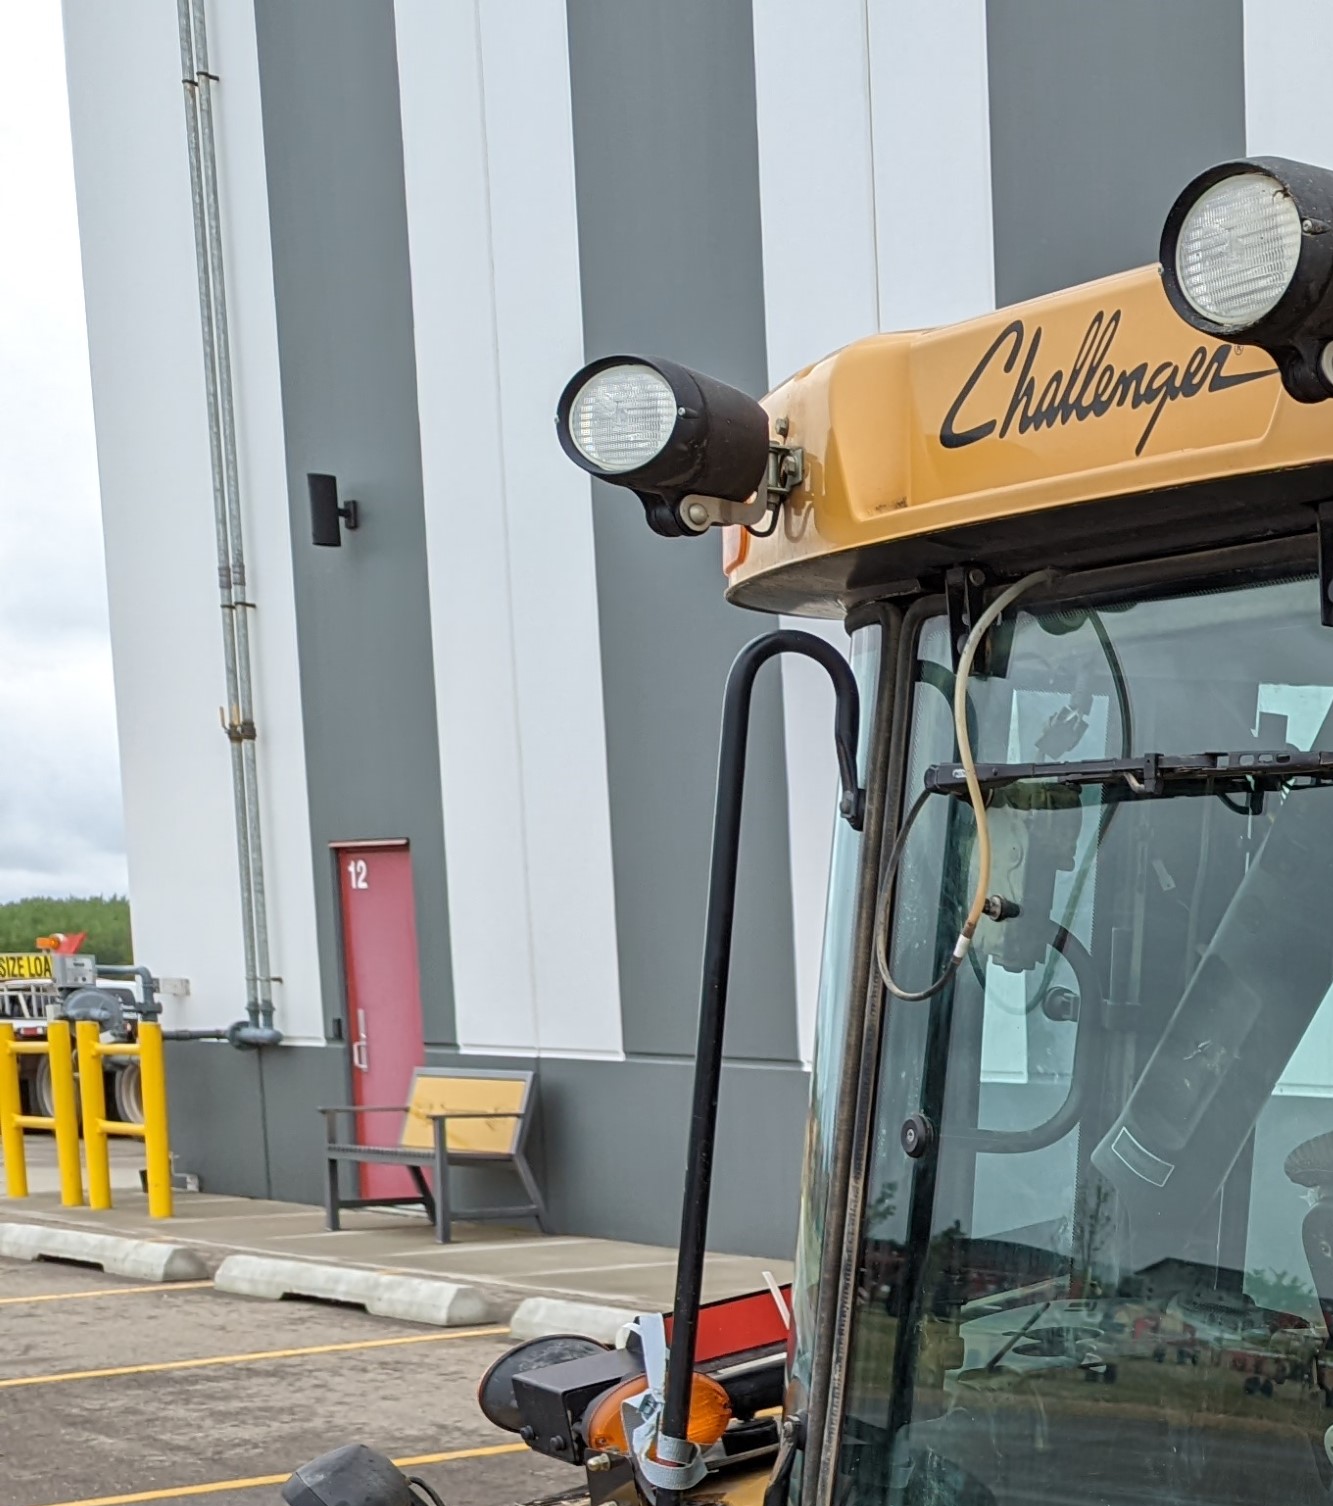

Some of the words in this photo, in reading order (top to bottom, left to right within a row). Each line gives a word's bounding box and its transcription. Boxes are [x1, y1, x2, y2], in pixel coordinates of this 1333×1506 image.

[939, 309, 1281, 457] Challenger
[348, 859, 368, 889] 12
[26, 954, 53, 978] LOA
